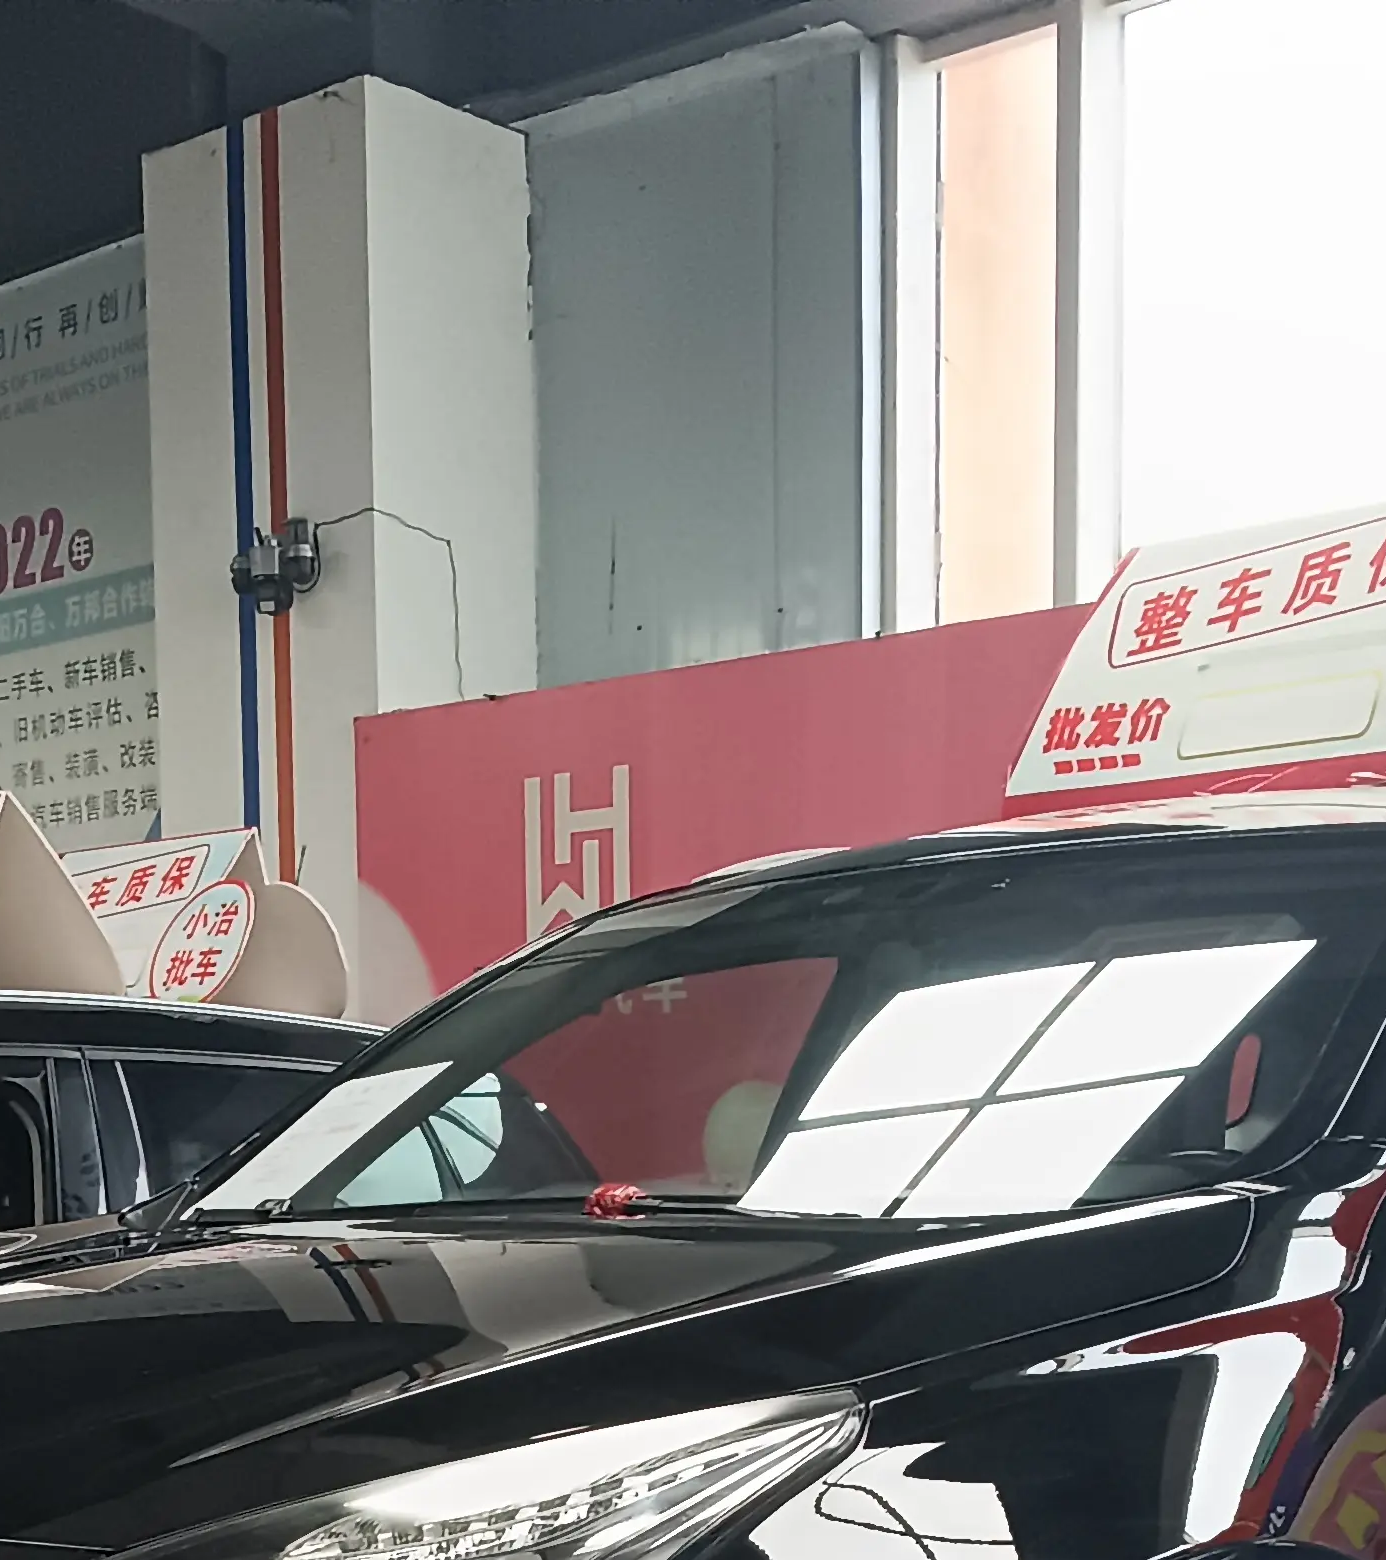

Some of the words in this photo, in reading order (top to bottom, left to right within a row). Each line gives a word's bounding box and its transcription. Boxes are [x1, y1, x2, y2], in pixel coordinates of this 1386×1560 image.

[1041, 696, 1170, 755] 批发价
[182, 899, 240, 940] 小治
[163, 946, 223, 992] 批车
